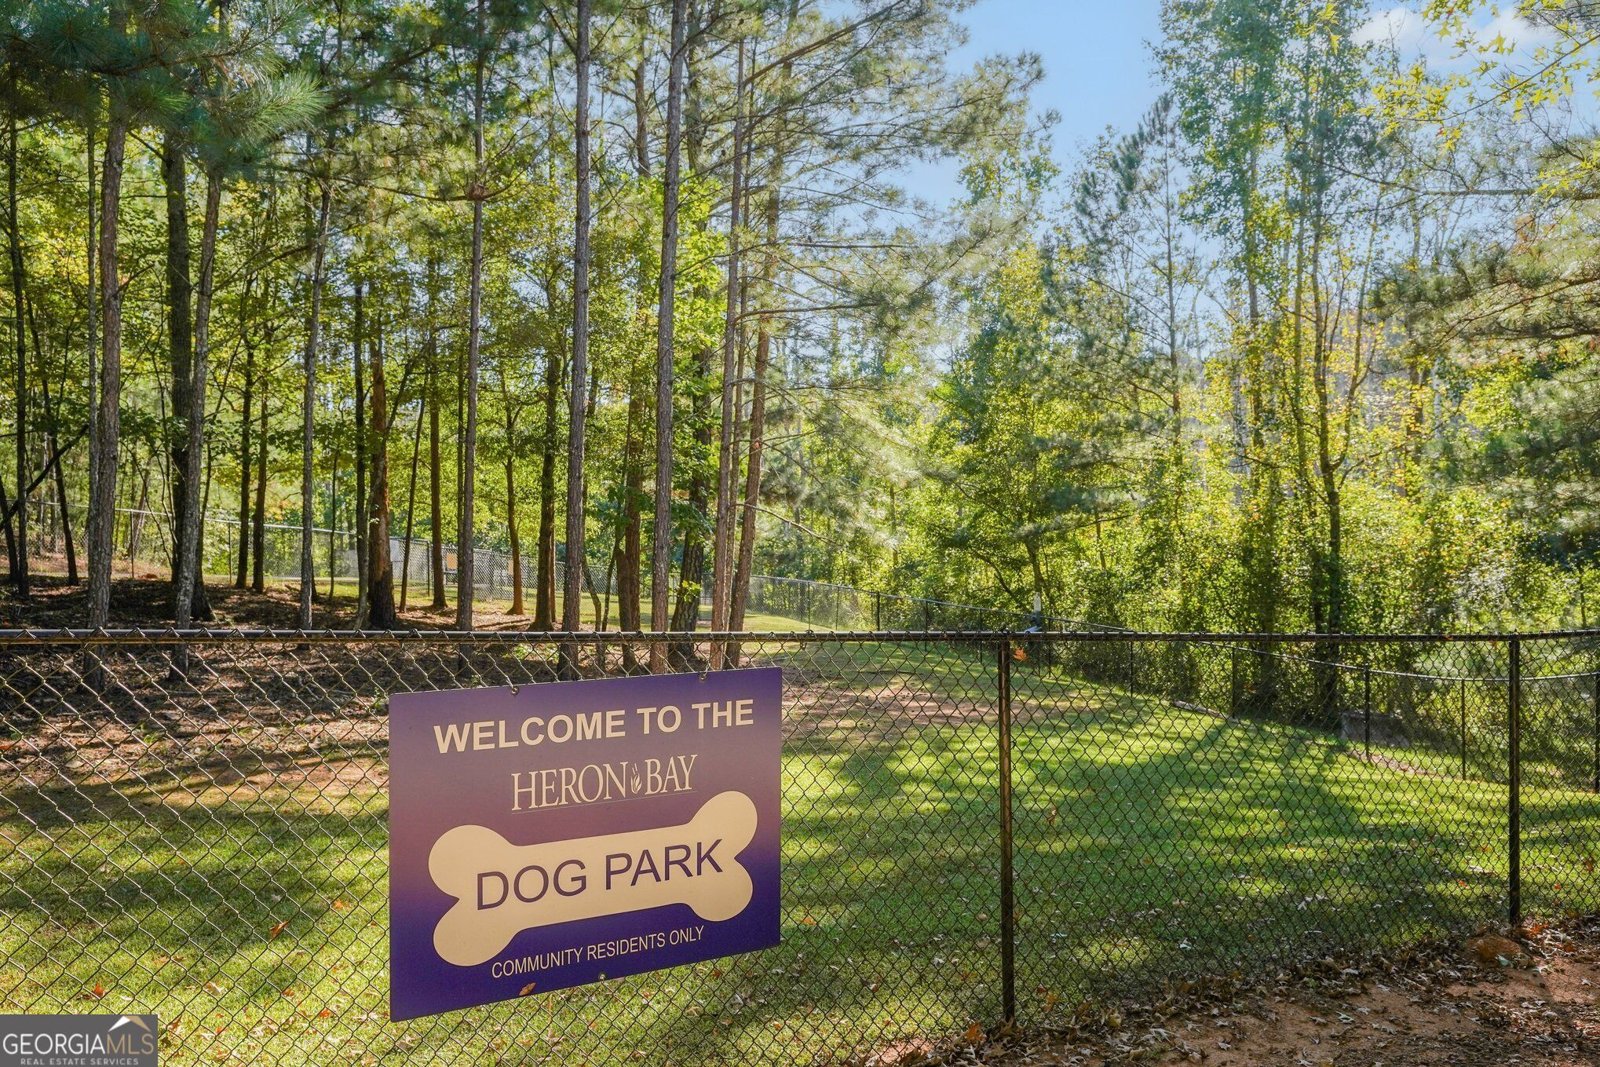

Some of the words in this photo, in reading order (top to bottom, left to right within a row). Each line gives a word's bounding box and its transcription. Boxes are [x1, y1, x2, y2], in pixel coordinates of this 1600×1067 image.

[433, 709, 626, 754] WELCOME
[637, 705, 682, 735] TO
[691, 699, 754, 730] THE
[511, 761, 628, 811] HERON
[644, 754, 698, 795] BAY
[476, 859, 587, 911] DOG
[605, 838, 723, 891] PARK
[491, 946, 583, 979] COMMUNITY
[587, 932, 666, 961] RESIDENTS
[669, 925, 705, 946] ONLY
